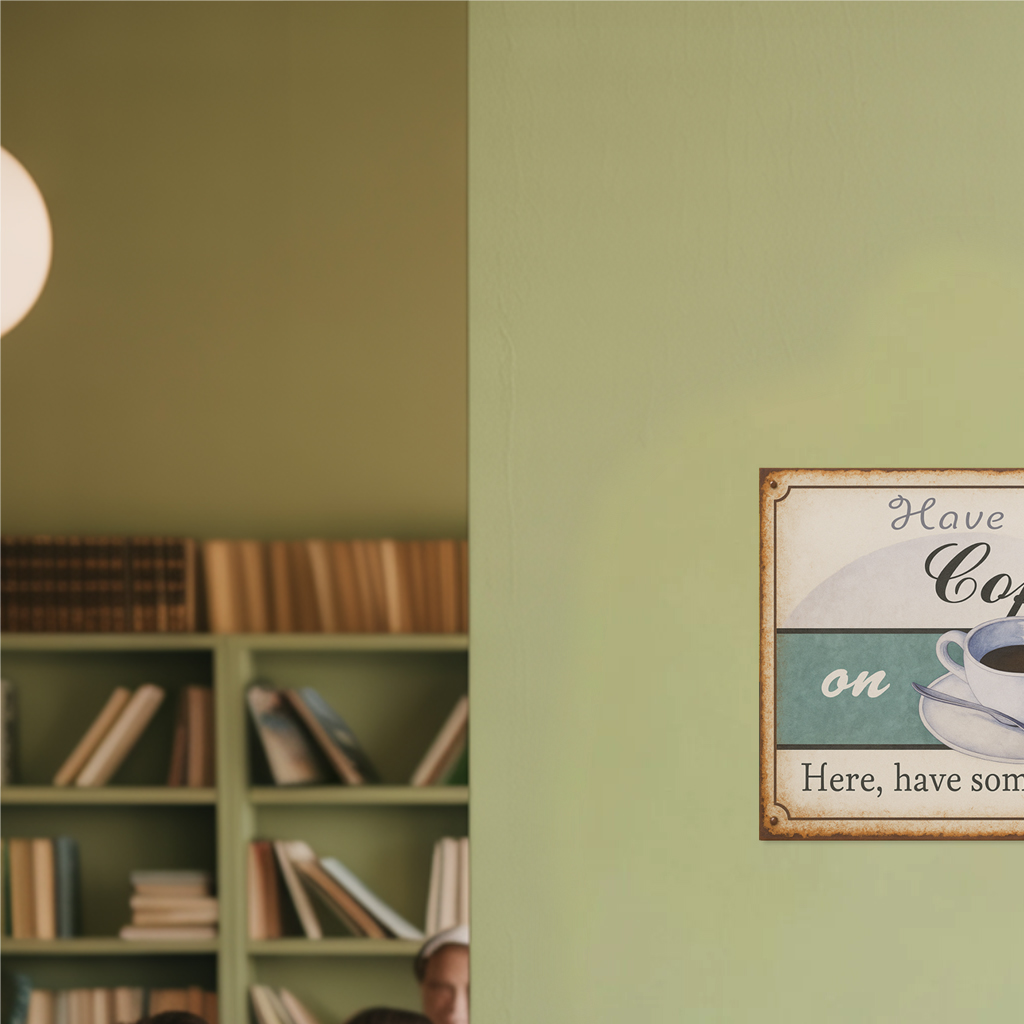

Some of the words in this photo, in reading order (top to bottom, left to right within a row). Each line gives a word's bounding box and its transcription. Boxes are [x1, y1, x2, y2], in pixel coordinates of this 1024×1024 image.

[888, 494, 1005, 531] Have
[821, 667, 891, 699] on
[801, 762, 883, 798] Here,
[894, 762, 962, 793] have
